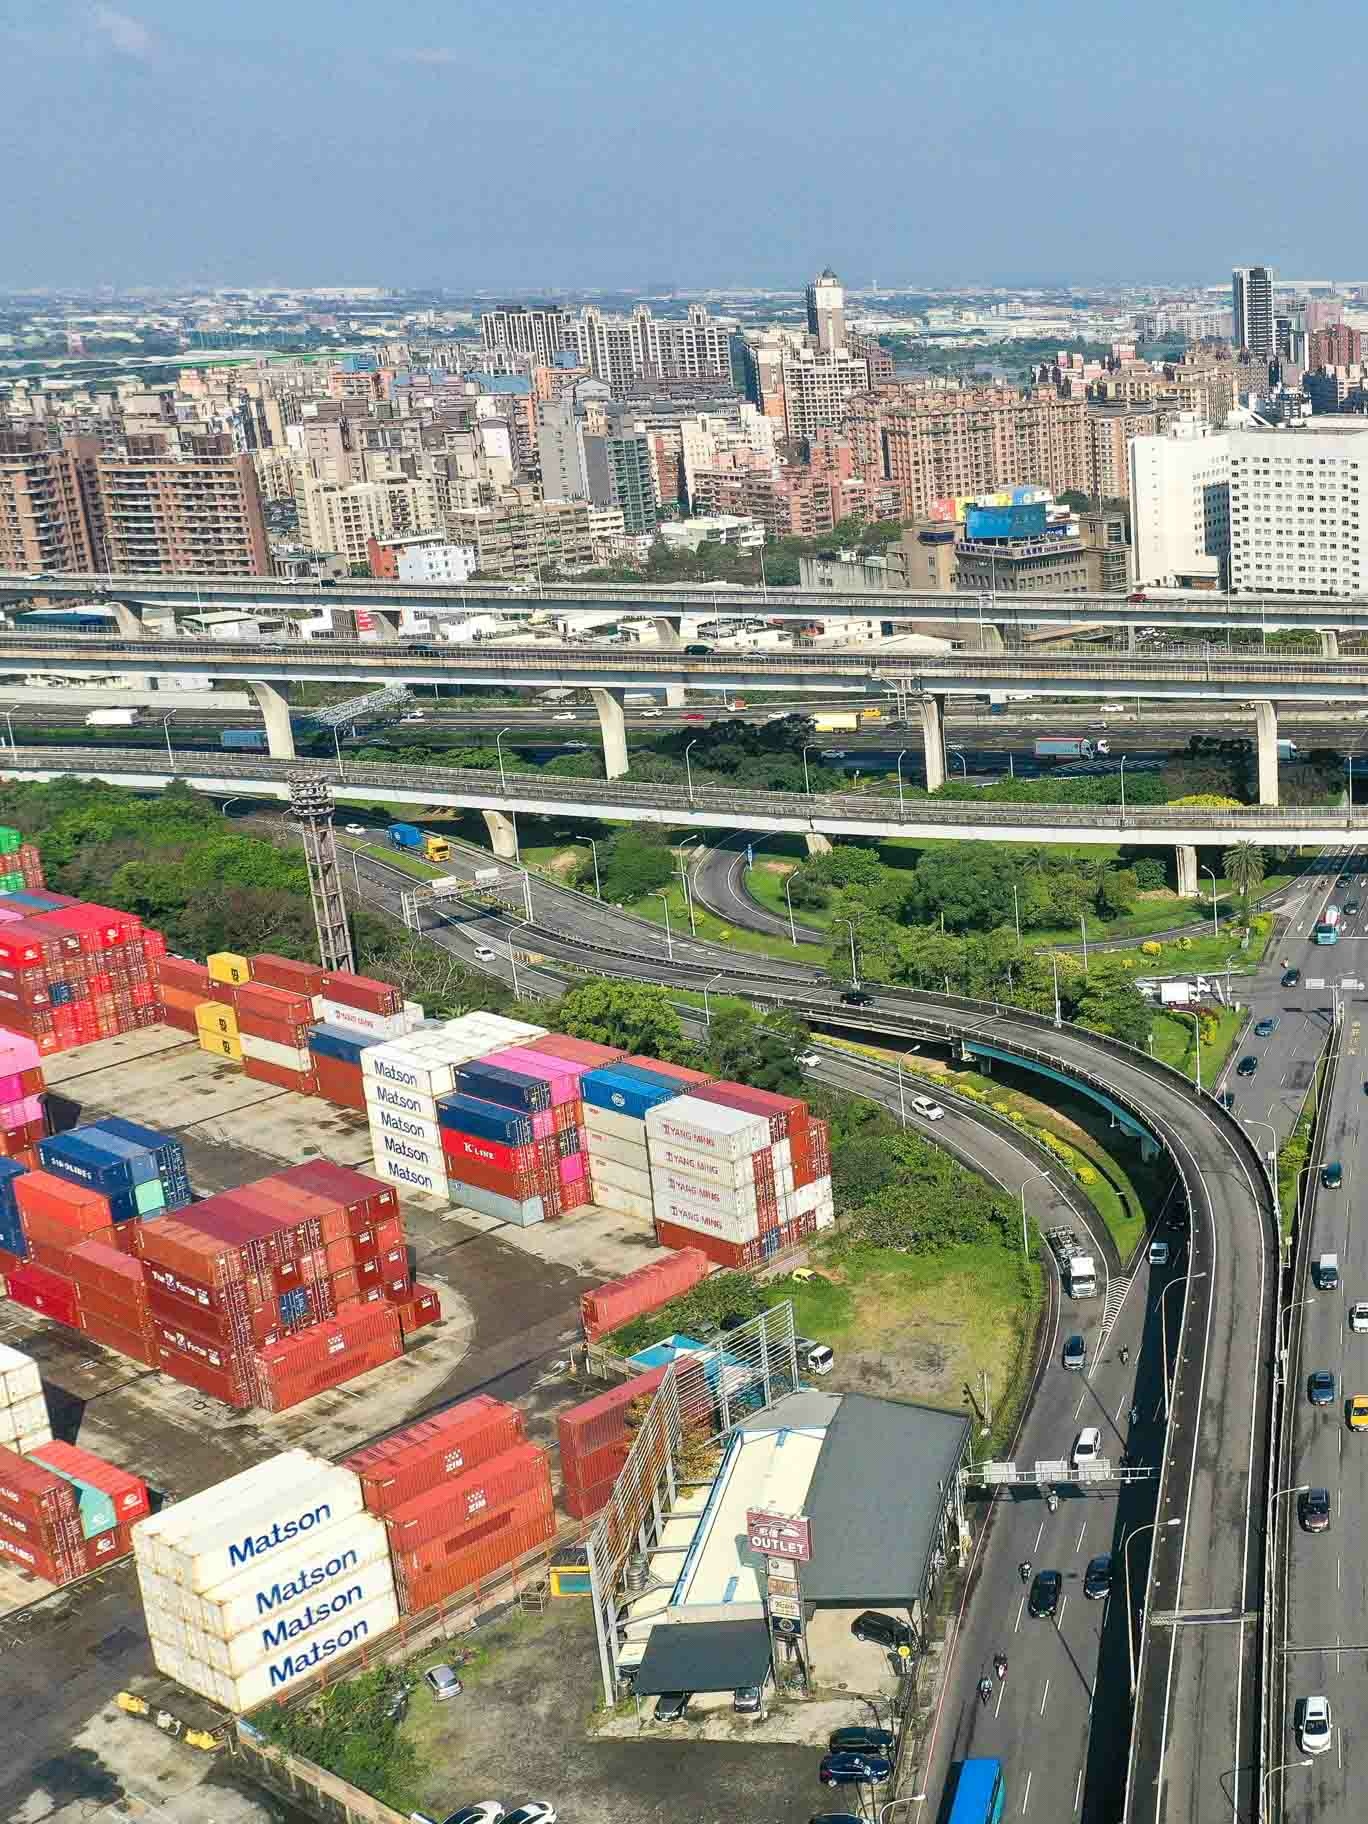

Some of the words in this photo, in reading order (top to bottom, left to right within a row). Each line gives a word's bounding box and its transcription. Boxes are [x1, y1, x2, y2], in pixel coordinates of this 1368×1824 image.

[374, 1060, 417, 1085] Matson
[377, 1086, 421, 1112] Matson
[381, 1112, 425, 1137] Matson
[384, 1136, 428, 1163] Matson
[388, 1161, 432, 1188] Matson
[228, 1503, 331, 1567] Matson
[751, 1535, 805, 1555] OUTLET
[256, 1549, 358, 1614] Matson
[262, 1584, 363, 1650] Matson
[269, 1618, 369, 1687] Matson
